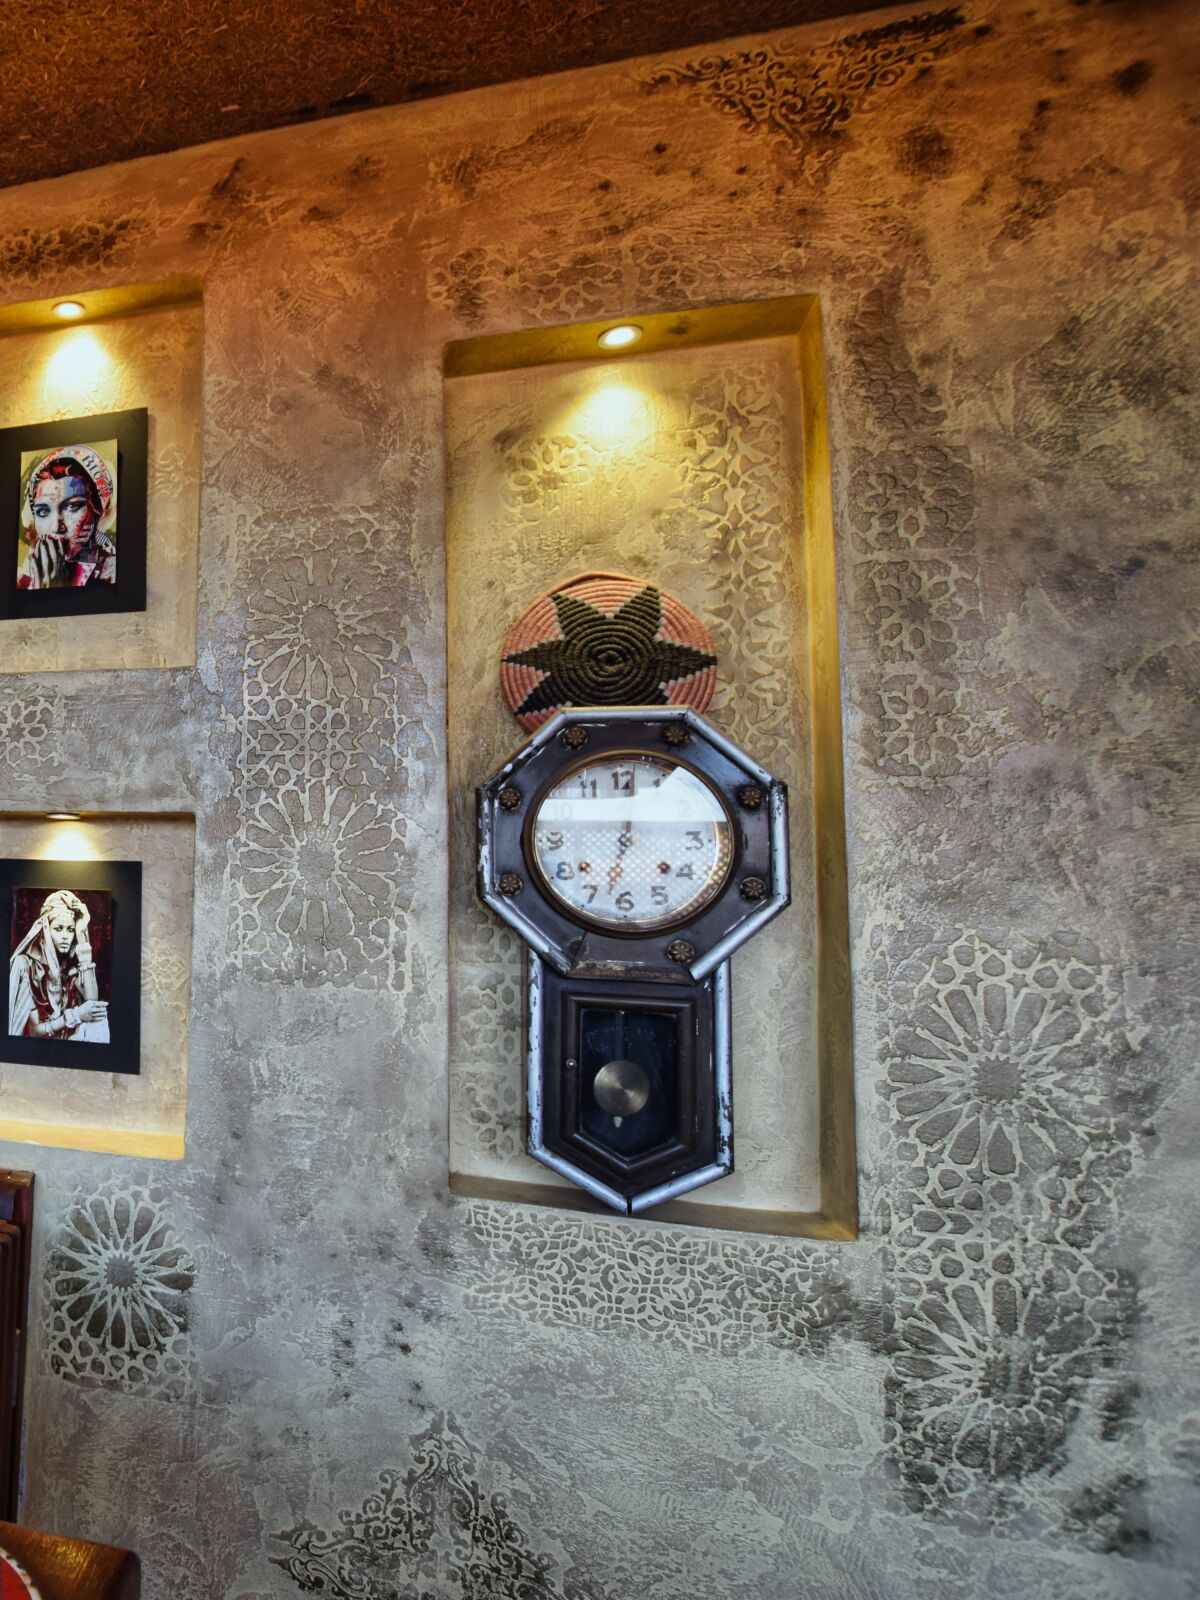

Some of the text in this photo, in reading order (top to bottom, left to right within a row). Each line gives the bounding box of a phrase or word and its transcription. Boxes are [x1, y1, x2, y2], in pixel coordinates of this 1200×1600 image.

[579, 778, 598, 799] 11
[611, 771, 633, 790] 12
[547, 831, 564, 851] 9
[685, 830, 705, 851] 3
[555, 861, 575, 881] 8
[676, 861, 696, 881] 4
[582, 884, 601, 904] 7
[615, 891, 634, 912] 6
[651, 885, 669, 906] 5
